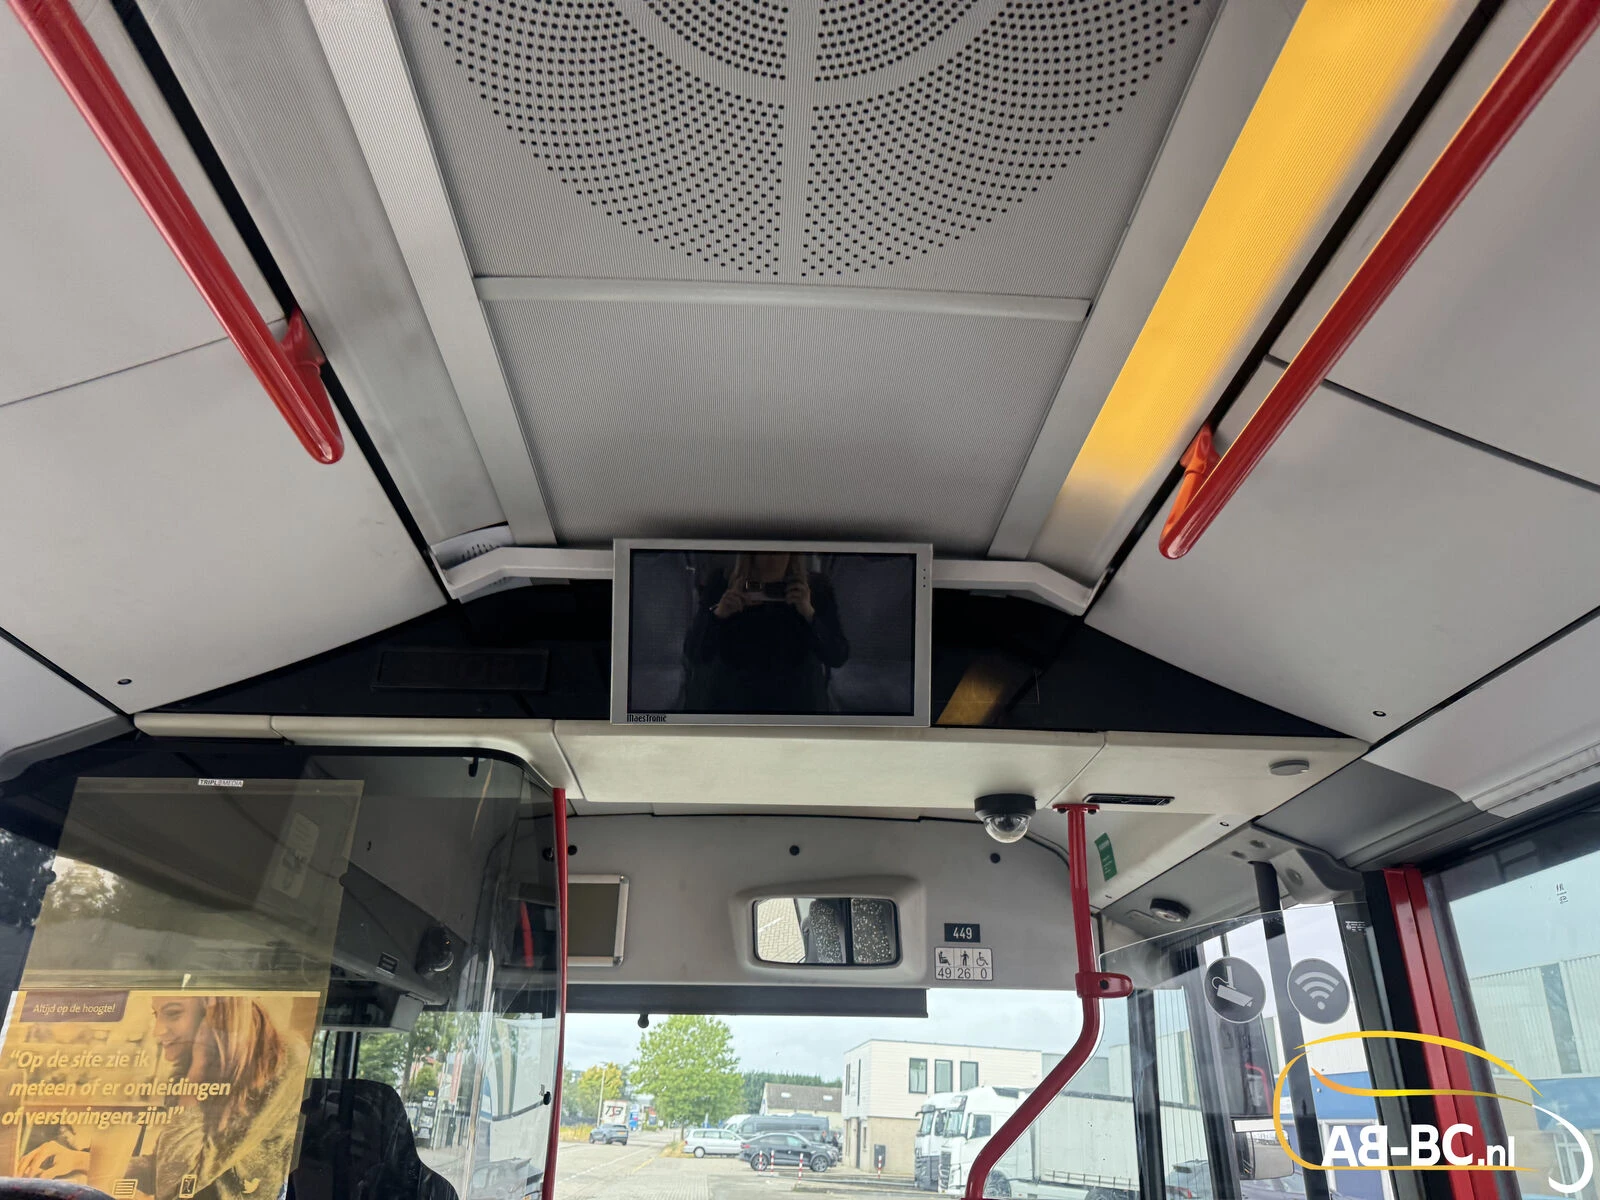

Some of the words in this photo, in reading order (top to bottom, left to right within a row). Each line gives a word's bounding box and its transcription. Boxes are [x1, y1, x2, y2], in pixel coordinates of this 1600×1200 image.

[953, 927, 973, 940] 449
[938, 967, 952, 979] 49
[957, 967, 971, 979] 26
[980, 967, 988, 979] 0
[32, 1003, 56, 1015] Altijd
[57, 1005, 68, 1015] op
[69, 1003, 81, 1013] de
[82, 1003, 116, 1016] hoogte!
[46, 1051, 71, 1068] de
[72, 1050, 102, 1068] site
[105, 1051, 130, 1068] zie
[133, 1050, 151, 1068] ik
[9, 1080, 77, 1097] meteen
[82, 1079, 102, 1097] of
[102, 1082, 123, 1097] er
[123, 1077, 231, 1101] omleidingen
[1, 1106, 25, 1125] of
[25, 1107, 134, 1129] verstoringen
